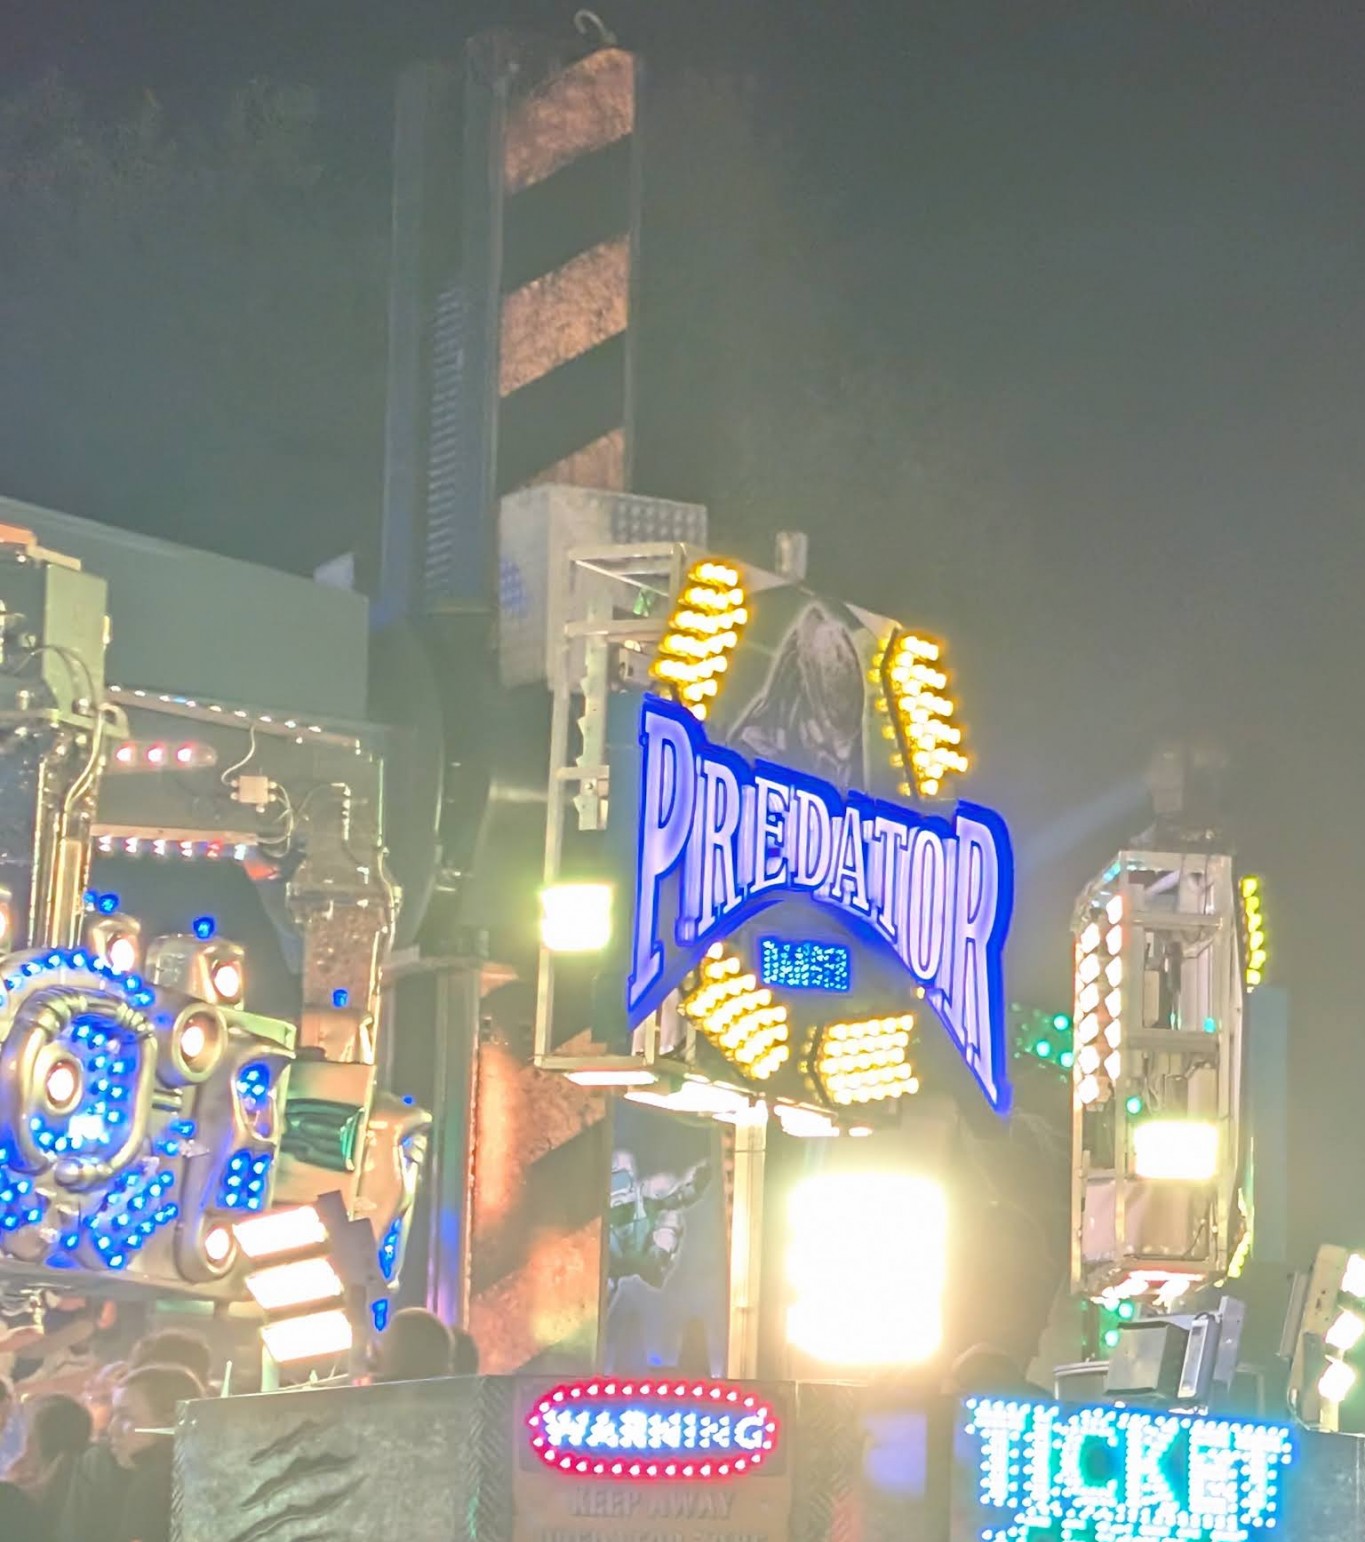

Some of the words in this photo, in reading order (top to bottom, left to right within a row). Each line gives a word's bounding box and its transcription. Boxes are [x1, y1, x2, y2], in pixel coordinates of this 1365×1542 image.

[629, 704, 1000, 1106] PREDATOR
[543, 1409, 765, 1449] WARNING
[966, 1398, 1293, 1528] TICKET
[573, 1485, 643, 1518] KEEP
[648, 1489, 736, 1521] AWAY
